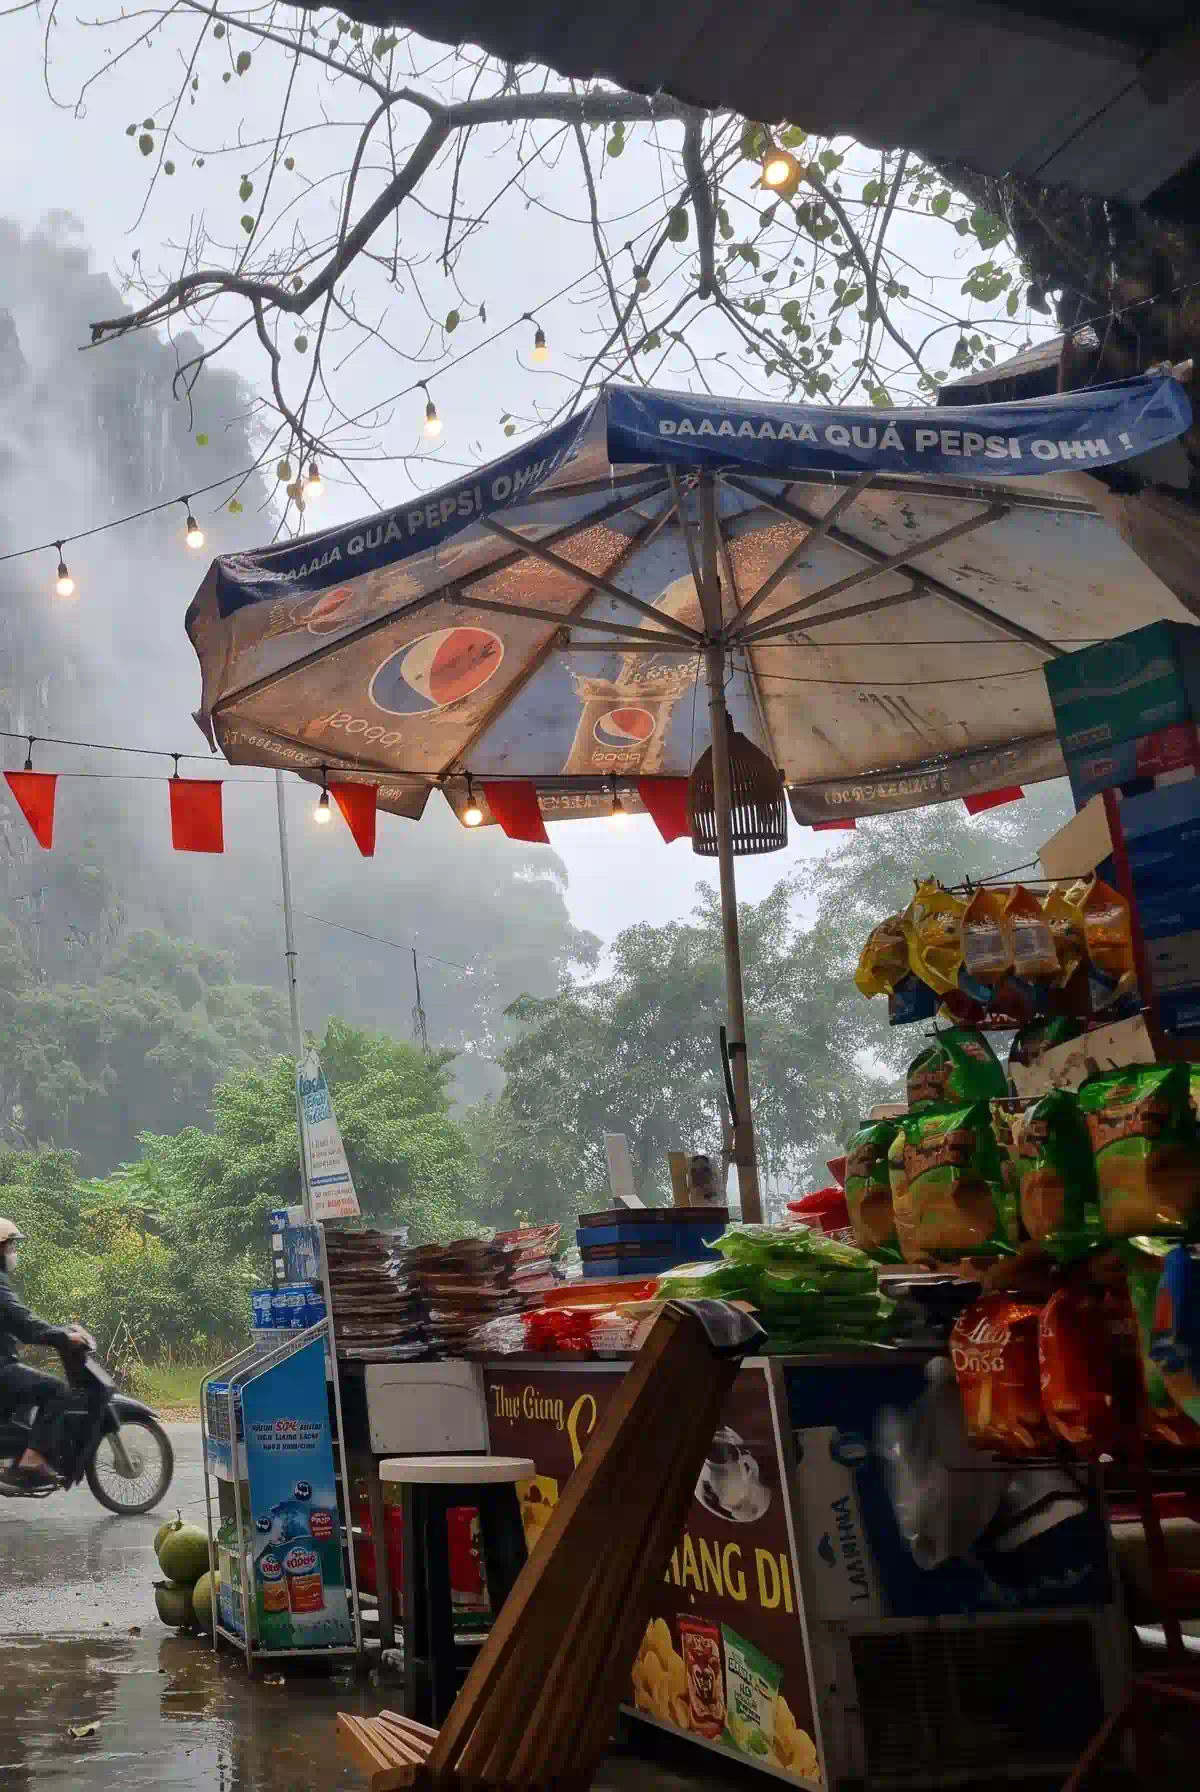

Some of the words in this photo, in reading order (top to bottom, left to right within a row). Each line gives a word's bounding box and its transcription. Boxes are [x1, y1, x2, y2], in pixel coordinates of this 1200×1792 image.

[825, 420, 905, 451] QUÁ
[915, 429, 1022, 459] PEPSI
[347, 515, 403, 556] QUÁ
[407, 488, 482, 537] PEPSI
[755, 1547, 794, 1613] DI
